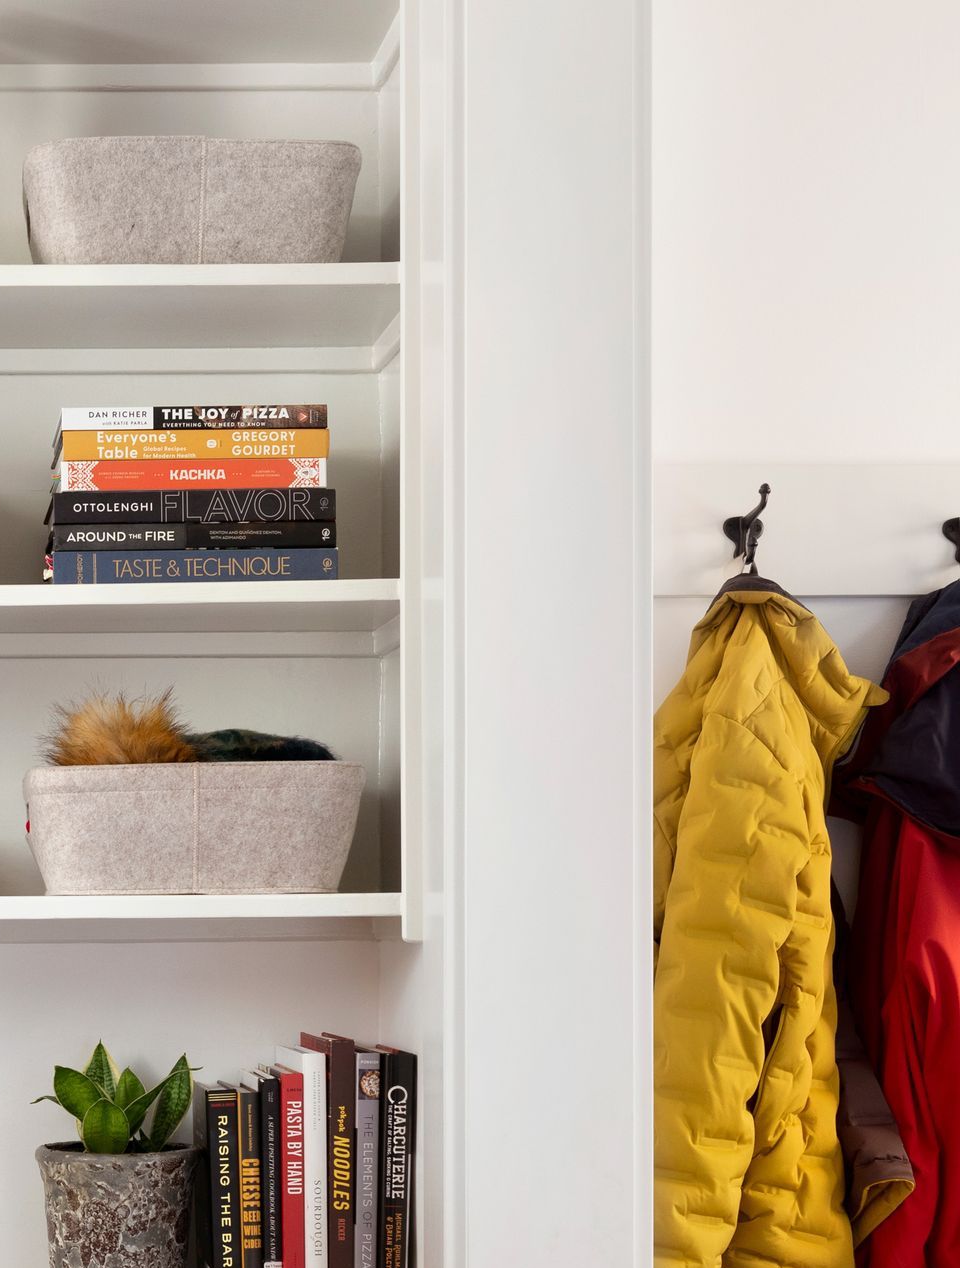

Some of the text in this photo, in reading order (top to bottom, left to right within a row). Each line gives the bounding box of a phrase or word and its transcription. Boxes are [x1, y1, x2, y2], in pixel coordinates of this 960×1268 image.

[162, 408, 290, 420] THE JOY of PIZZA
[96, 430, 177, 446] Everyone's
[232, 431, 296, 442] GREGORY
[96, 446, 138, 459] Table
[232, 444, 296, 456] GOURDET
[169, 469, 226, 480] KACHKA
[73, 502, 153, 512] OTTOLENGHI
[160, 489, 314, 522] FLAVOR
[66, 532, 126, 542] AROUND
[145, 530, 175, 541] FIRE
[112, 556, 292, 578] TASTE & TECHNIQUE
[286, 1101, 302, 1138] PASTA
[364, 1114, 374, 1137] THE
[218, 1115, 230, 1186] RAISING
[287, 1142, 302, 1156] BY
[388, 1086, 408, 1199] CHARCUTERIE
[242, 1158, 260, 1208] CHEESE
[287, 1161, 302, 1195] HAND
[333, 1136, 350, 1211] NOODLES
[362, 1142, 374, 1207] ELEMENTS
[220, 1192, 232, 1228] THE
[244, 1210, 260, 1222] BEER
[313, 1179, 322, 1256] SOURDOUGH
[362, 1212, 372, 1228] OF
[244, 1224, 261, 1236] WINE
[338, 1218, 346, 1241] RICKER
[394, 1213, 402, 1242] MICHAEL
[222, 1233, 233, 1268] BAR
[244, 1238, 262, 1249] CIDER
